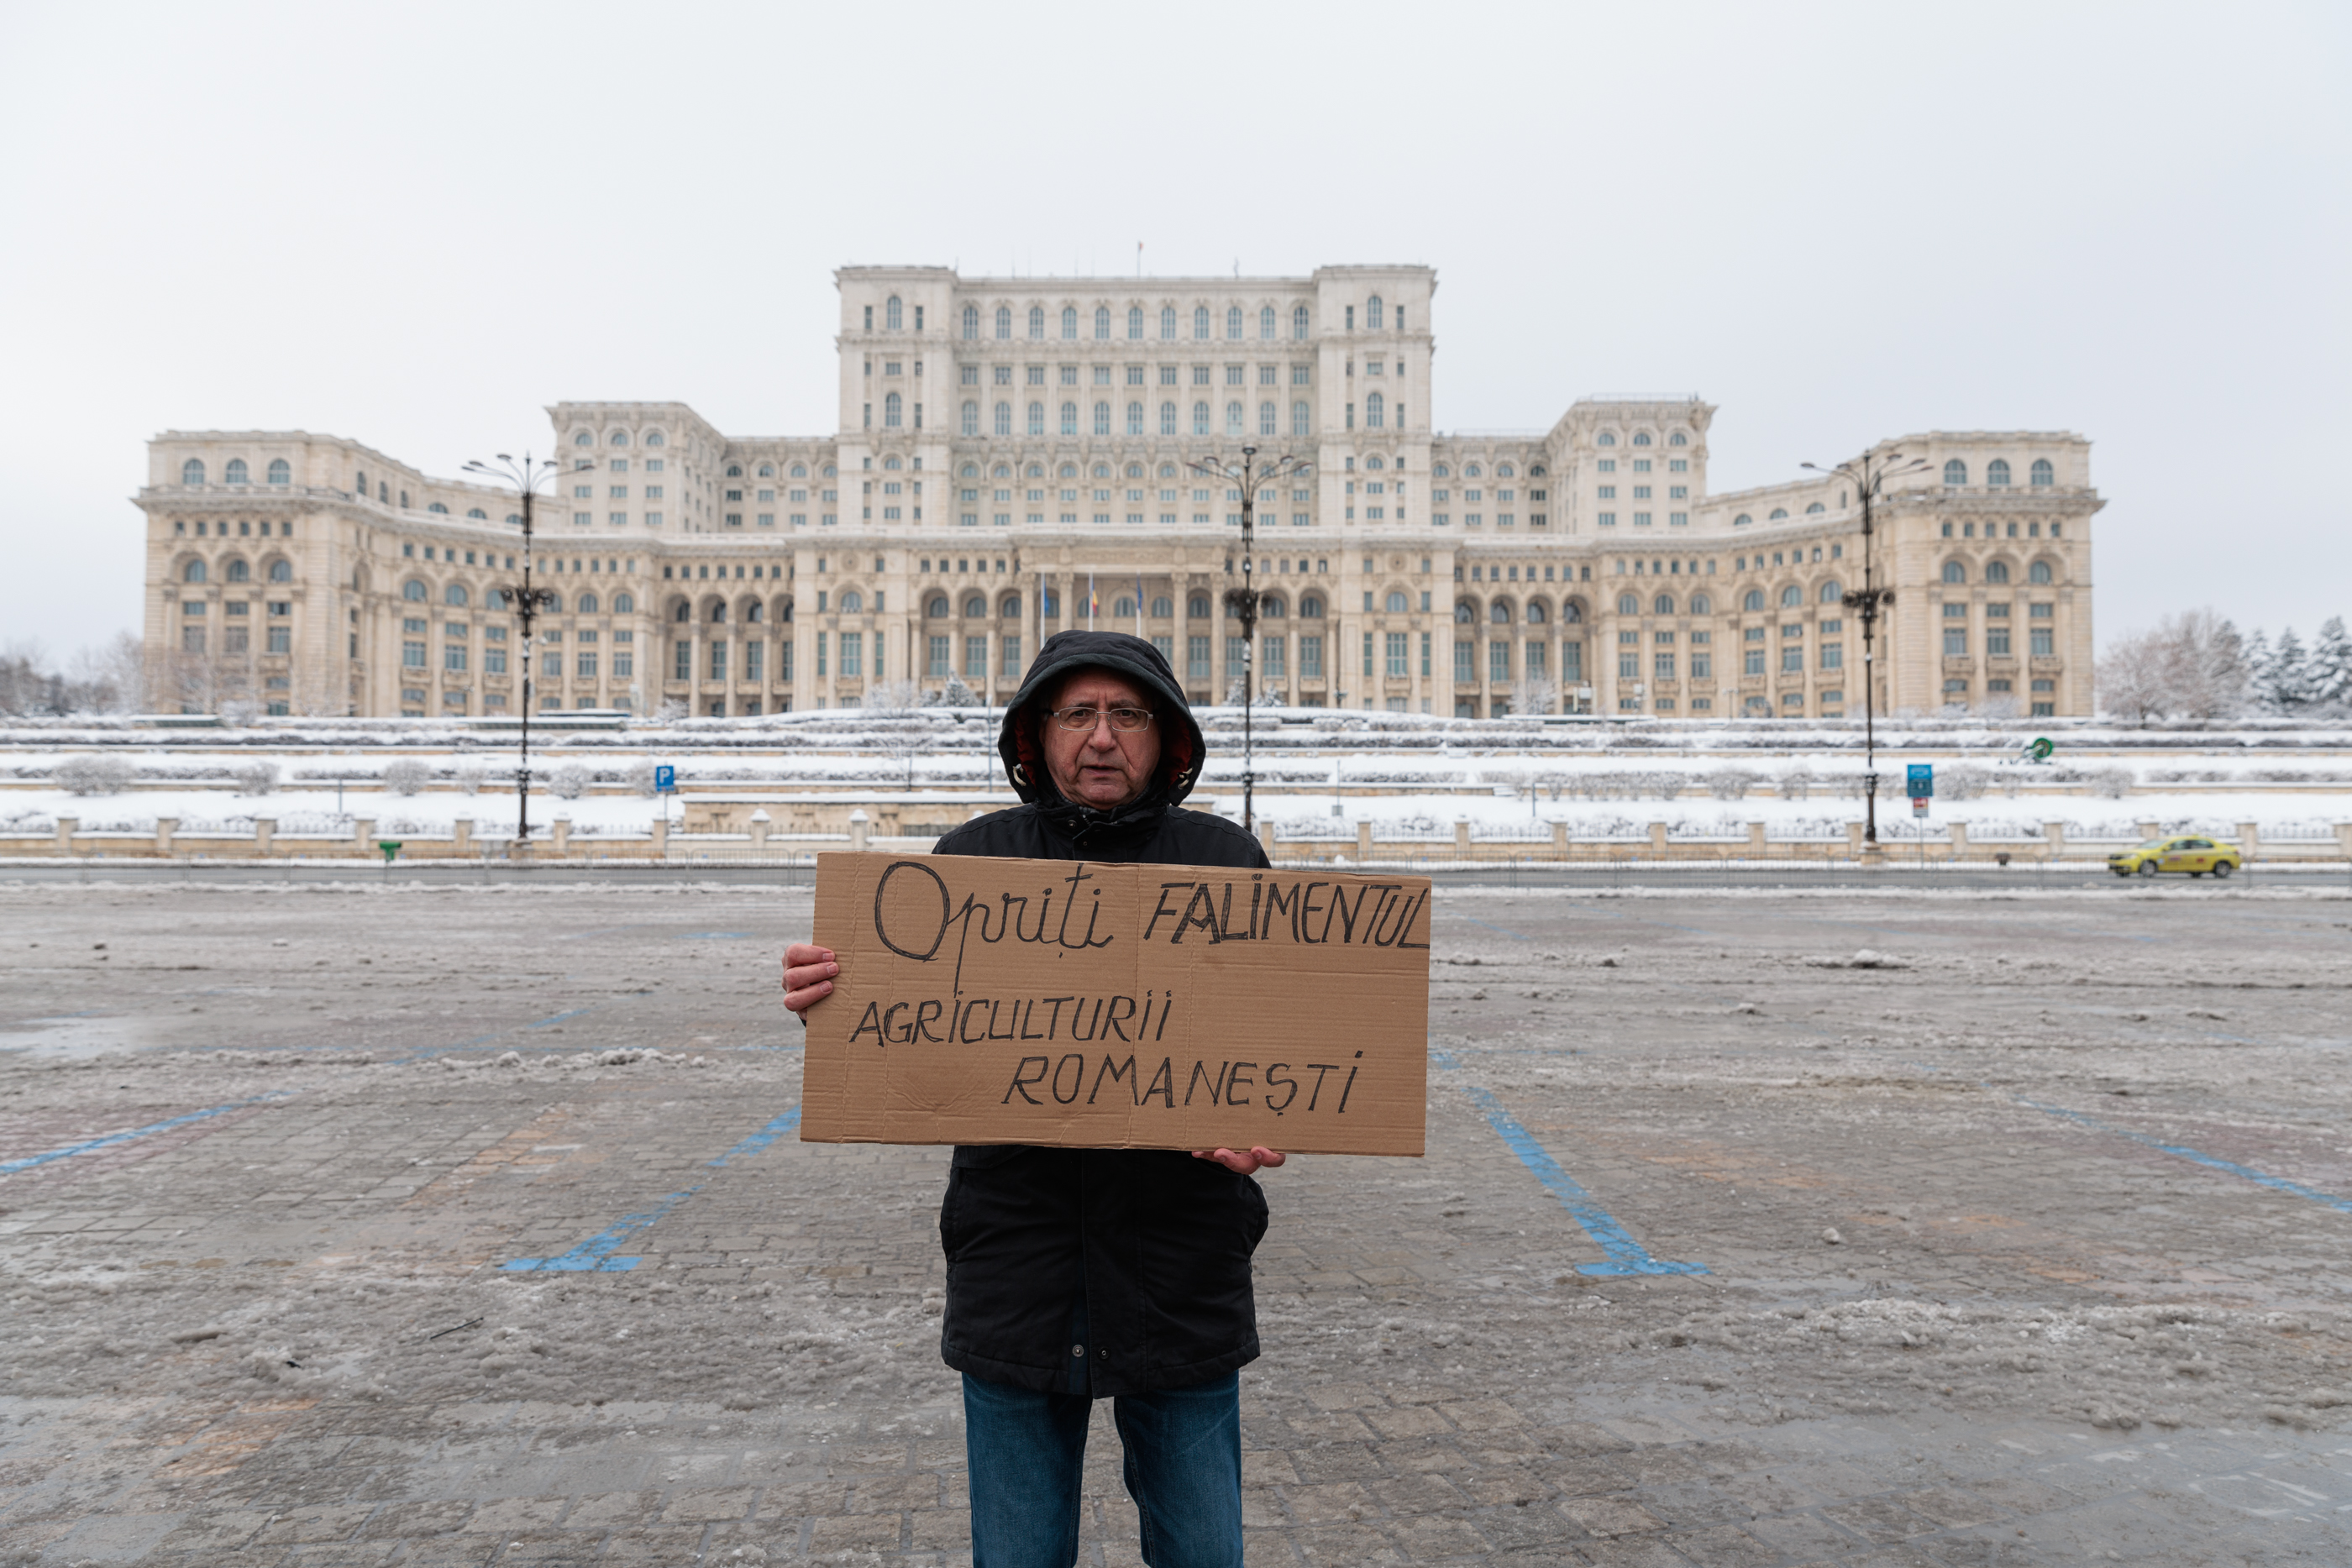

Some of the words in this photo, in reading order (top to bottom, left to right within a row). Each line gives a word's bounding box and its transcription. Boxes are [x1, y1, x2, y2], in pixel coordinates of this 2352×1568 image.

[659, 767, 671, 784] P
[1143, 873, 1430, 948] FALIMENTUL
[848, 989, 1173, 1047] AGRICULTURII
